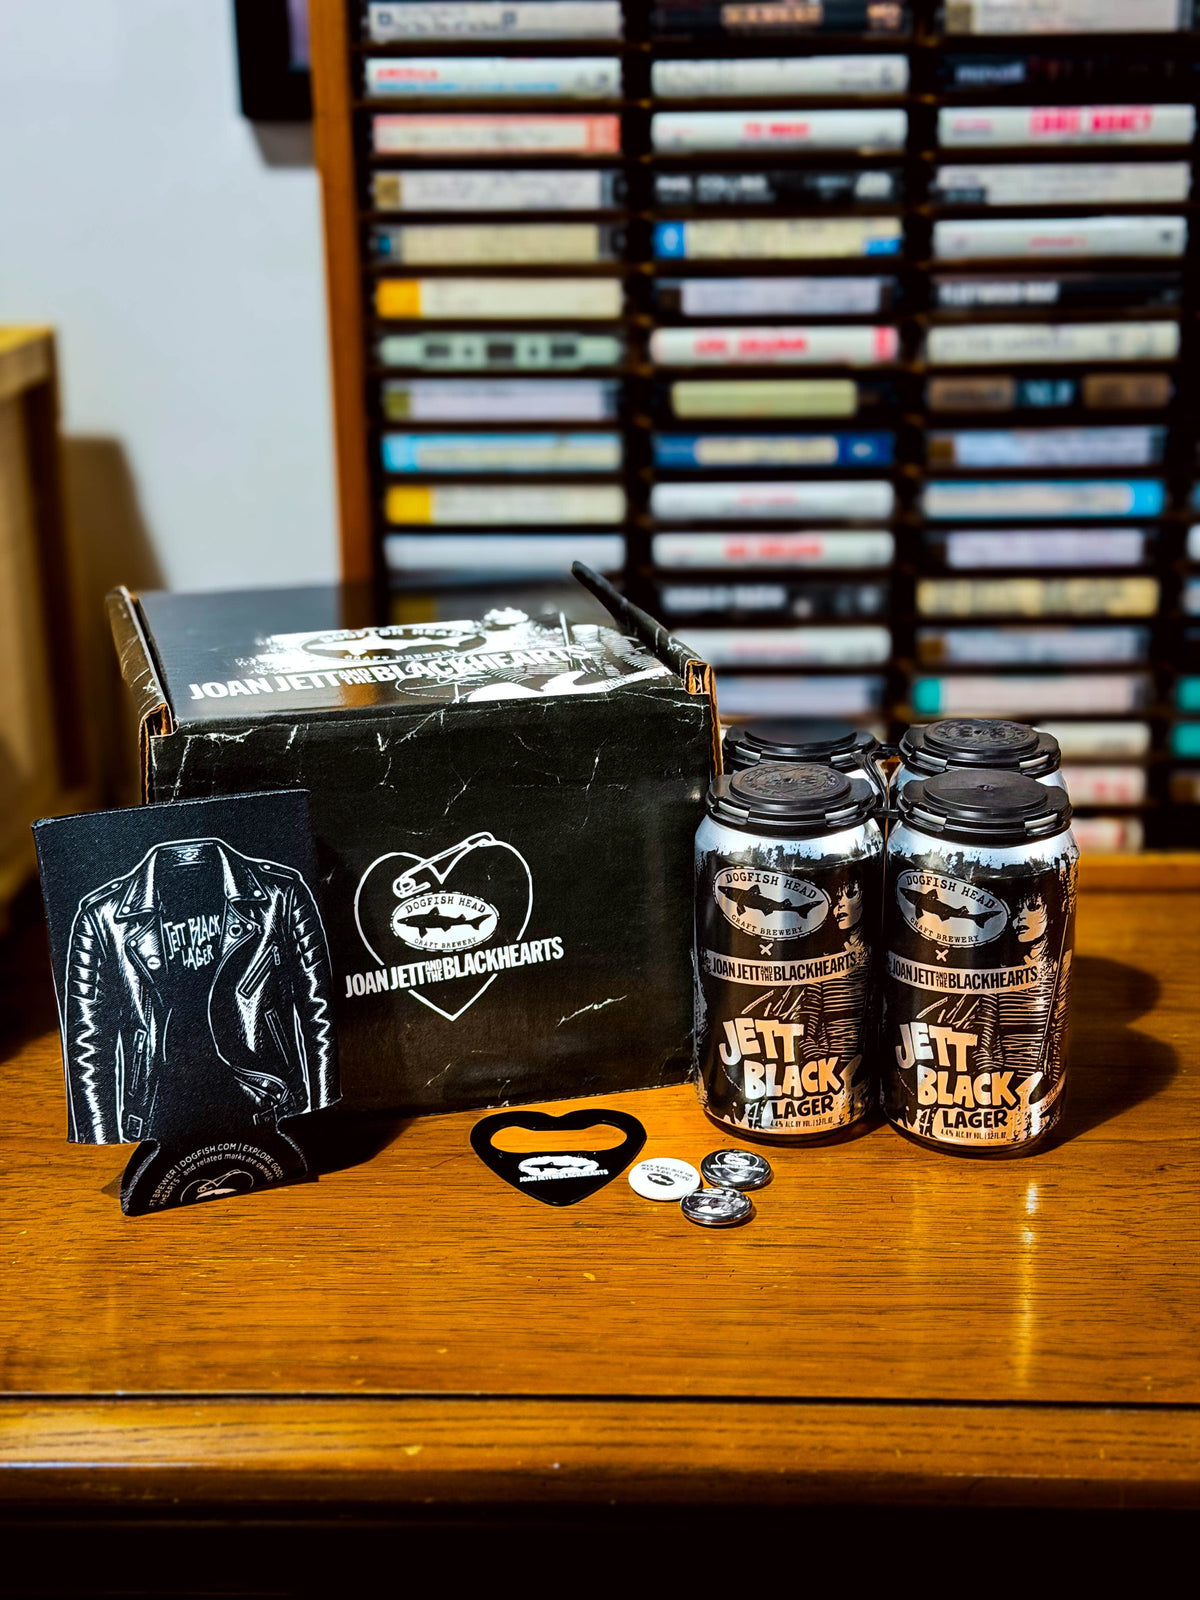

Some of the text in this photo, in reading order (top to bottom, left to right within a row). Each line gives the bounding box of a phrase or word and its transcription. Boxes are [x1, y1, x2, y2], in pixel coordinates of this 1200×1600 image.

[189, 644, 593, 701] JOAN JETT AND THE BLACKHEARTS
[726, 871, 817, 900] DOGFISH HEAD
[906, 875, 996, 909] DOGFISH HEAD
[405, 896, 487, 915] DOGFISH HEAD
[163, 914, 221, 960] JETT BLACK
[731, 914, 803, 937] CRAFT BREWERY
[910, 917, 980, 943] CRAFT BREWERY
[182, 944, 215, 971] LAGER
[413, 936, 477, 949] CRAFT BREWERY
[345, 936, 565, 999] JOAN JETT AND THE BLACKHEARTS
[712, 952, 857, 982] JOAN JETT AND THE BLACKHEARTS
[891, 958, 1038, 990] JOAN JETT AND THE BLACKHEARTS
[719, 1017, 804, 1066] JETT
[895, 1022, 978, 1072] JETT
[743, 1056, 842, 1100] BLACK
[917, 1064, 1018, 1109] BLACK
[771, 1095, 834, 1119] LAGER
[942, 1109, 1008, 1129] LAGER
[152, 1169, 177, 1198] BREWER
[179, 1142, 237, 1168] DOGFISH.COM
[242, 1144, 275, 1165] EXPLORE
[182, 1163, 197, 1176] and
[196, 1153, 223, 1168] related
[223, 1153, 246, 1162] marks
[245, 1156, 258, 1165] are
